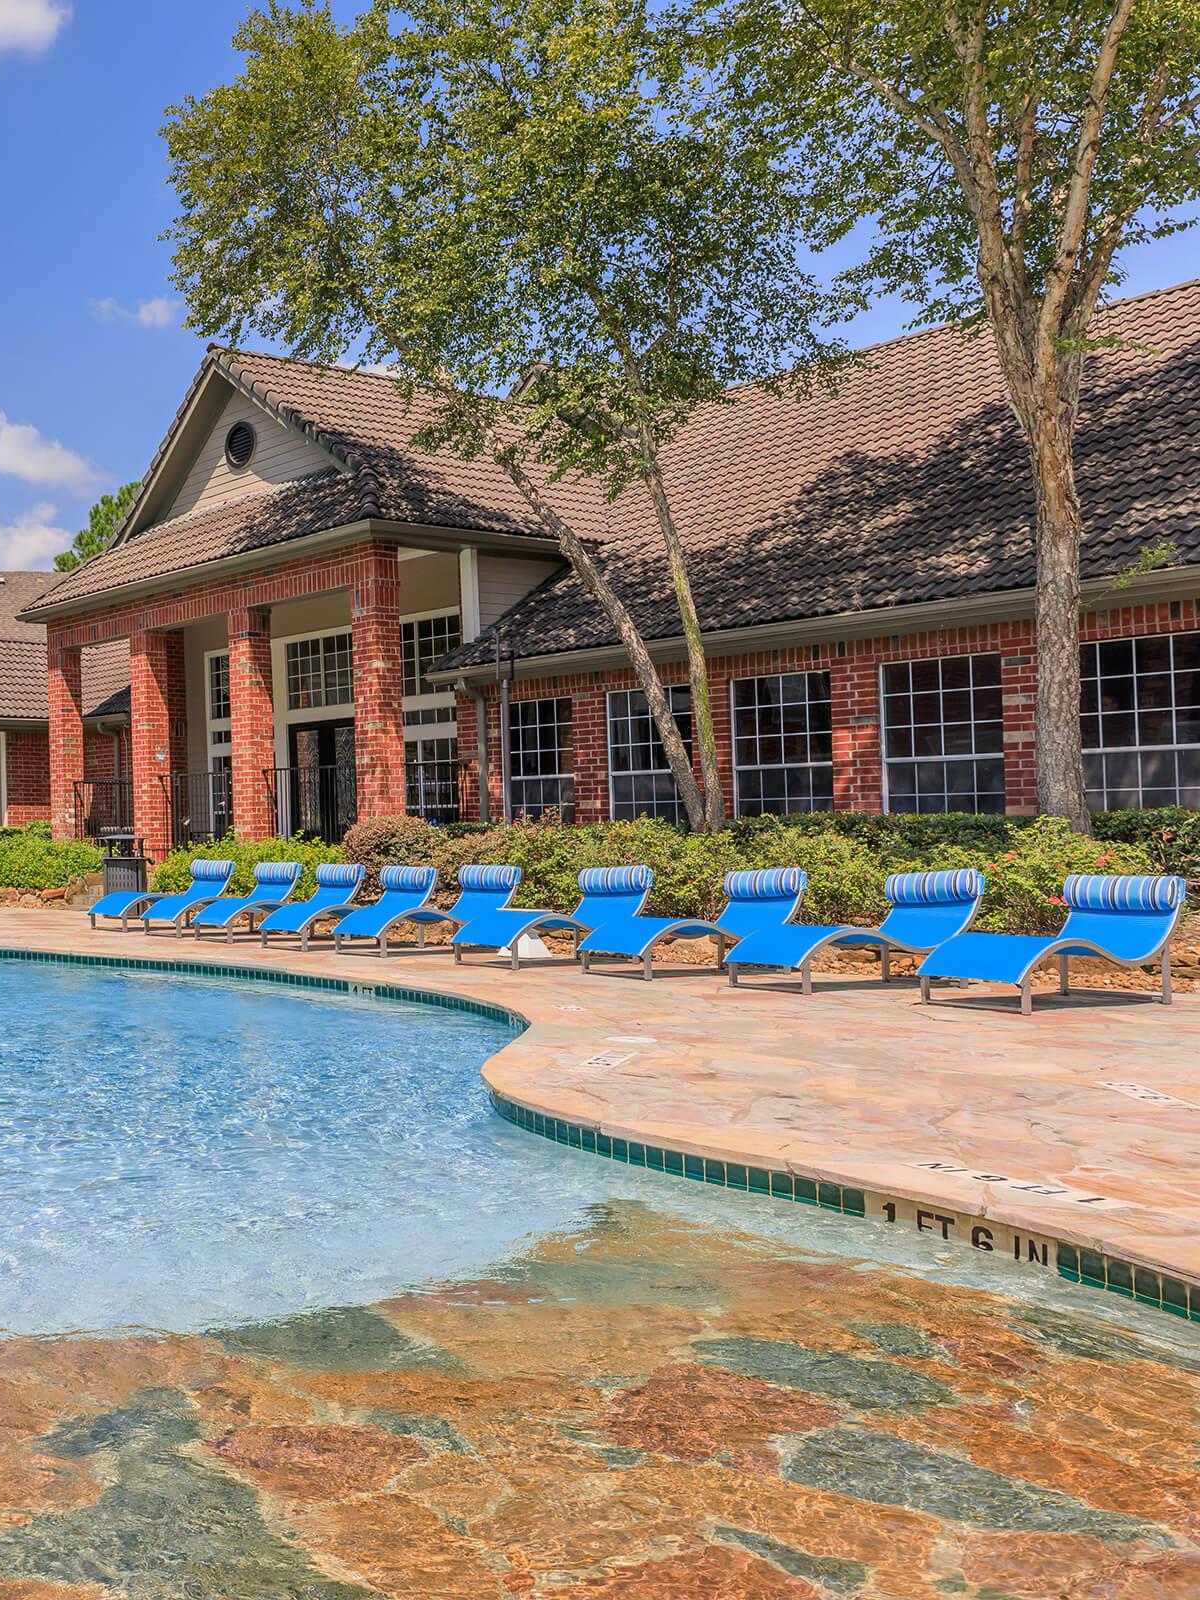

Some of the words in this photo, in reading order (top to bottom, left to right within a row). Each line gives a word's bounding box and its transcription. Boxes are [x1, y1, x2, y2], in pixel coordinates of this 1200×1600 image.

[882, 1202, 896, 1223] 1
[917, 1209, 955, 1240] FT
[971, 1225, 994, 1251] 6
[1014, 1235, 1048, 1266] IN
